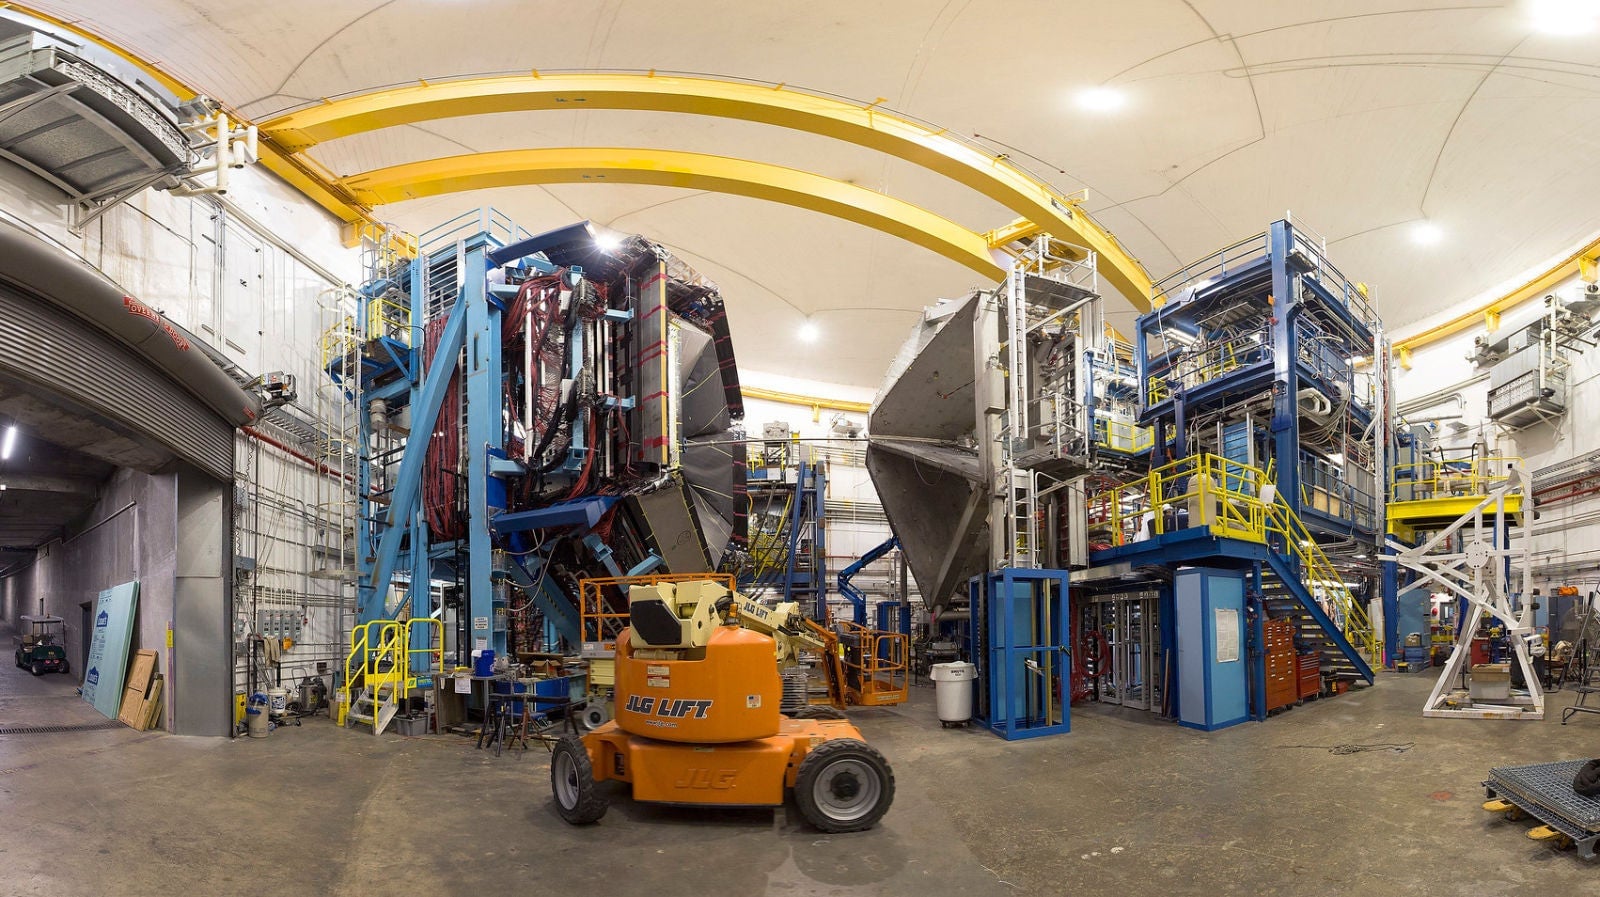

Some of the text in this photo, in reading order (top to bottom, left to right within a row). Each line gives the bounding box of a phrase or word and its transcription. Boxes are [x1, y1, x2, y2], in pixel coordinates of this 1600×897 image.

[744, 602, 755, 615] JLG
[625, 694, 714, 719] JLG LIFT
[674, 768, 737, 790] JLG
